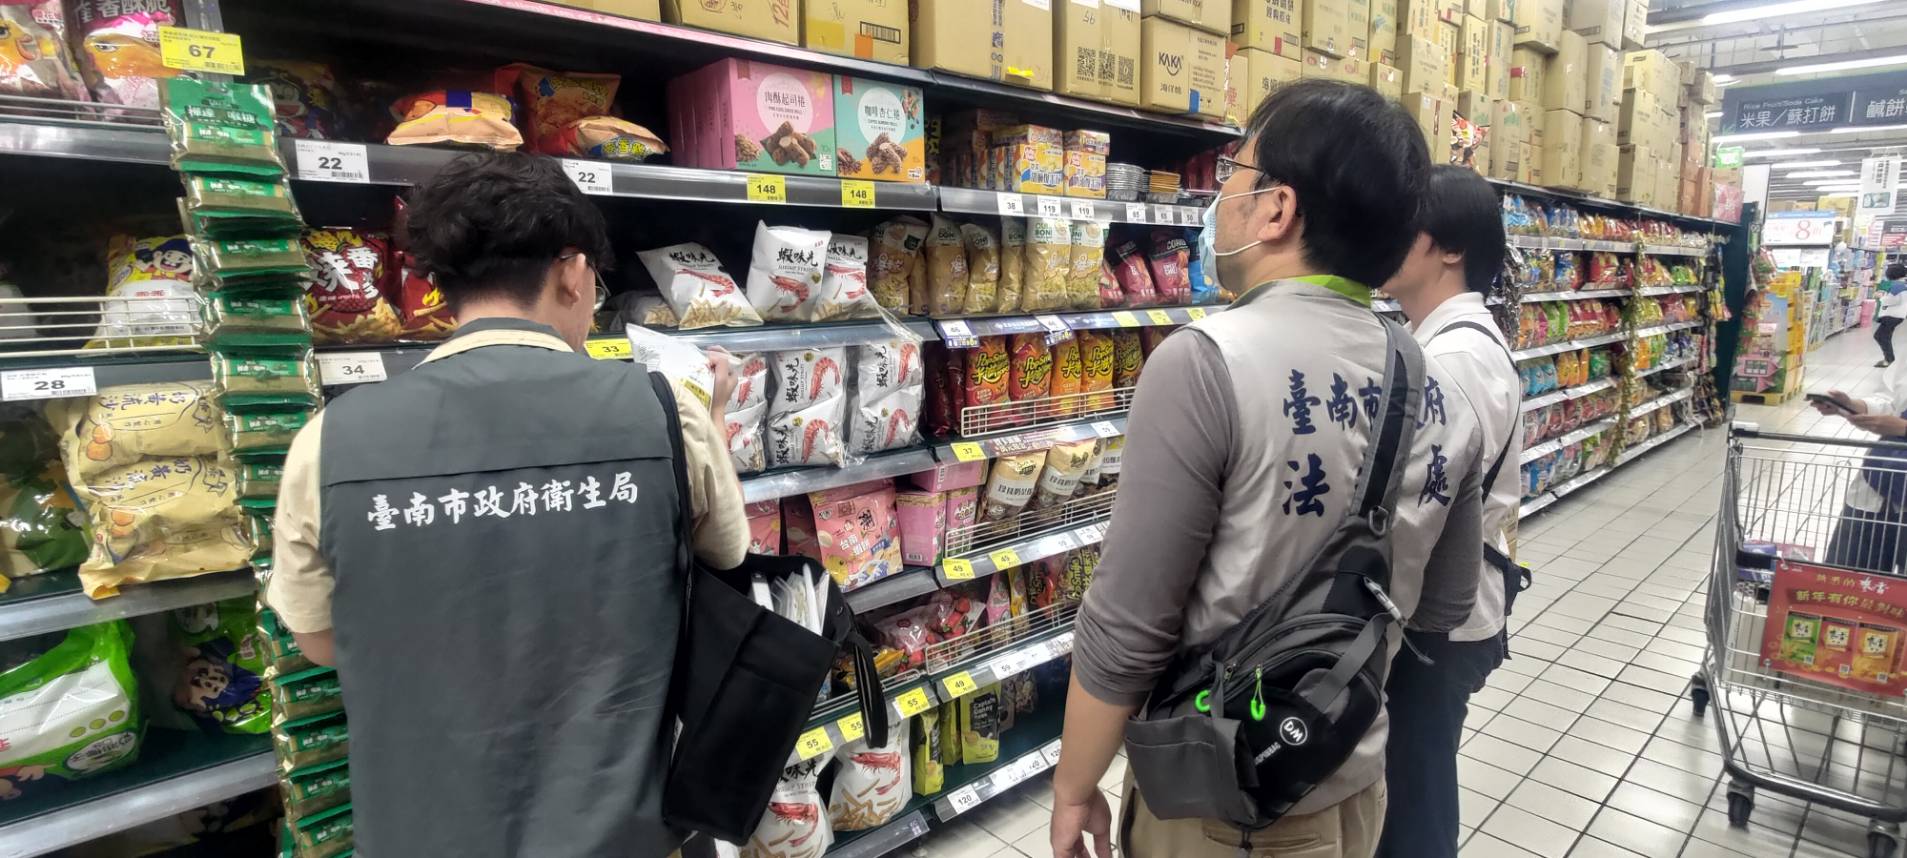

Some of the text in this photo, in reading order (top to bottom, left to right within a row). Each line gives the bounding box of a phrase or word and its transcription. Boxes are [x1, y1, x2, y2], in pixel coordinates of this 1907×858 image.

[188, 44, 216, 59] 67
[1158, 52, 1183, 68] KAKA
[318, 156, 343, 171] 22
[578, 171, 596, 184] 22
[756, 184, 776, 195] 148
[850, 189, 867, 200] 148
[1043, 204, 1056, 213] 119
[602, 345, 620, 353] 33
[343, 364, 365, 376] 34
[34, 379, 66, 391] 28
[1282, 367, 1446, 435] 臺南市府
[962, 447, 973, 455] 37
[1282, 443, 1451, 509] 法處
[366, 471, 639, 532] 臺南市政府衛生局
[954, 679, 965, 688] 49
[907, 698, 918, 708] 55
[1283, 720, 1303, 743] DM
[806, 739, 819, 749] 55
[780, 758, 818, 782] 味先
[957, 794, 972, 806] 120
